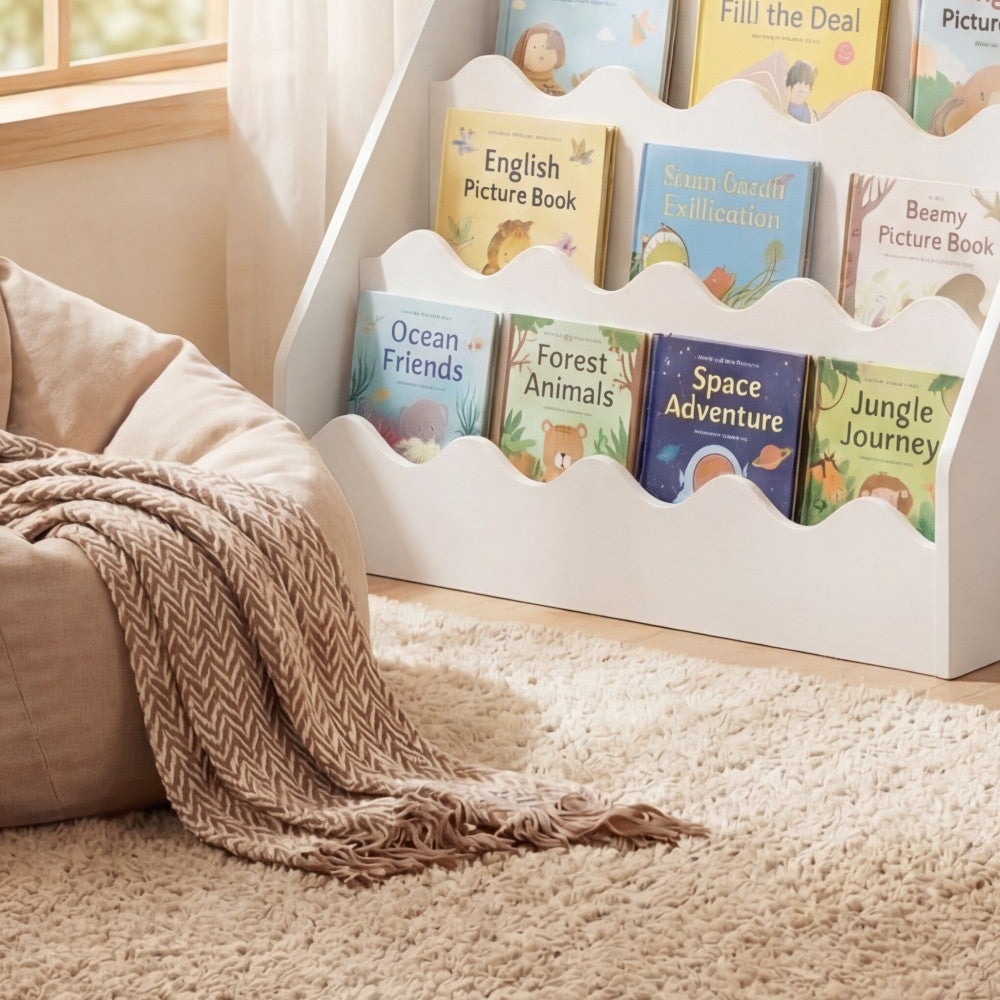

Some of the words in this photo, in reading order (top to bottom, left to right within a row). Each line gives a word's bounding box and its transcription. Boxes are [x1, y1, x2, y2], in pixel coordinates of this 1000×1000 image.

[767, 2, 803, 28] the
[811, 5, 861, 32] Deal
[485, 148, 560, 183] English
[464, 178, 527, 205] Picture
[531, 187, 577, 210] Book
[906, 199, 967, 230] Beamy
[879, 225, 942, 250] Picture
[947, 232, 994, 256] Book
[391, 319, 459, 351] Ocean
[383, 347, 464, 382] Friends
[537, 343, 608, 375] Forest
[523, 372, 614, 408] Animals
[692, 365, 762, 399] Space
[664, 393, 784, 433] Adventure
[851, 390, 933, 429] Jungle
[840, 421, 940, 466] Journey
